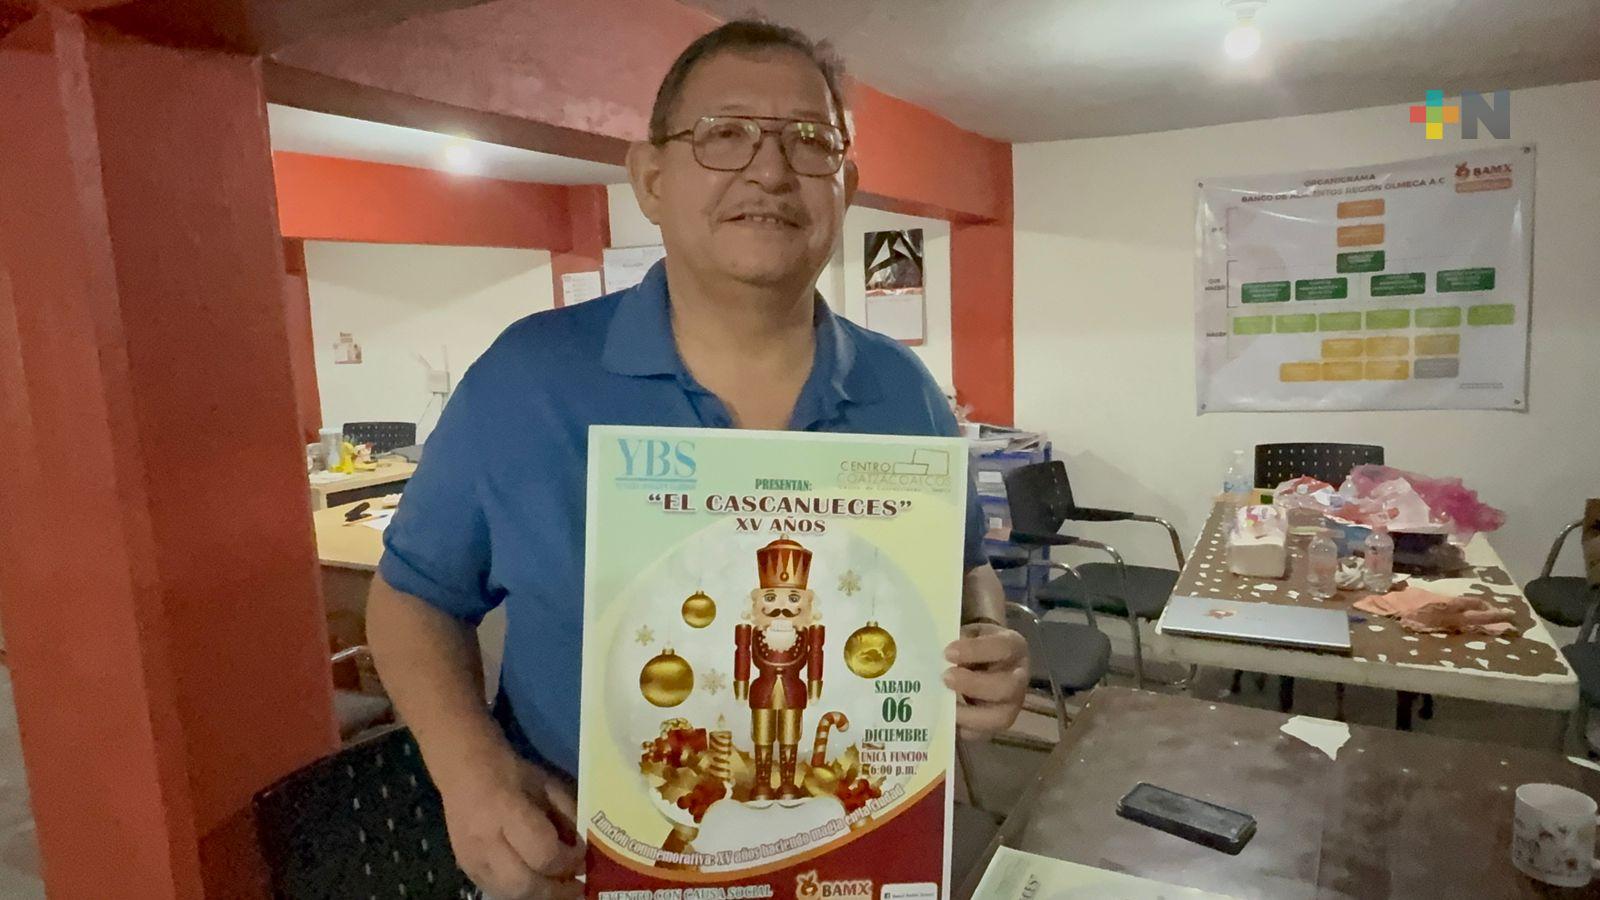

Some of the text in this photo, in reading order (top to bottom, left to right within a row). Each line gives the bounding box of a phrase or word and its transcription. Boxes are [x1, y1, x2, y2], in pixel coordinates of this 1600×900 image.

[1472, 163, 1513, 177] BAMX
[1241, 194, 1273, 203] BANCO
[1384, 178, 1427, 190] OLMECA
[617, 438, 697, 478] YBS
[840, 460, 892, 474] CENTRO
[755, 478, 813, 492] PRESENTAN:
[736, 515, 827, 533] XV AÑOS
[874, 680, 922, 694] SABADO
[882, 696, 913, 723] 06
[864, 728, 929, 743] DICIEMBRE
[890, 750, 929, 762] FUNCION
[590, 810, 630, 849] Función
[716, 850, 733, 867] XV
[733, 845, 762, 864] años
[810, 817, 846, 843] magia
[868, 783, 906, 813] ciudad
[654, 890, 683, 900] CON
[821, 882, 871, 898] BAMX
